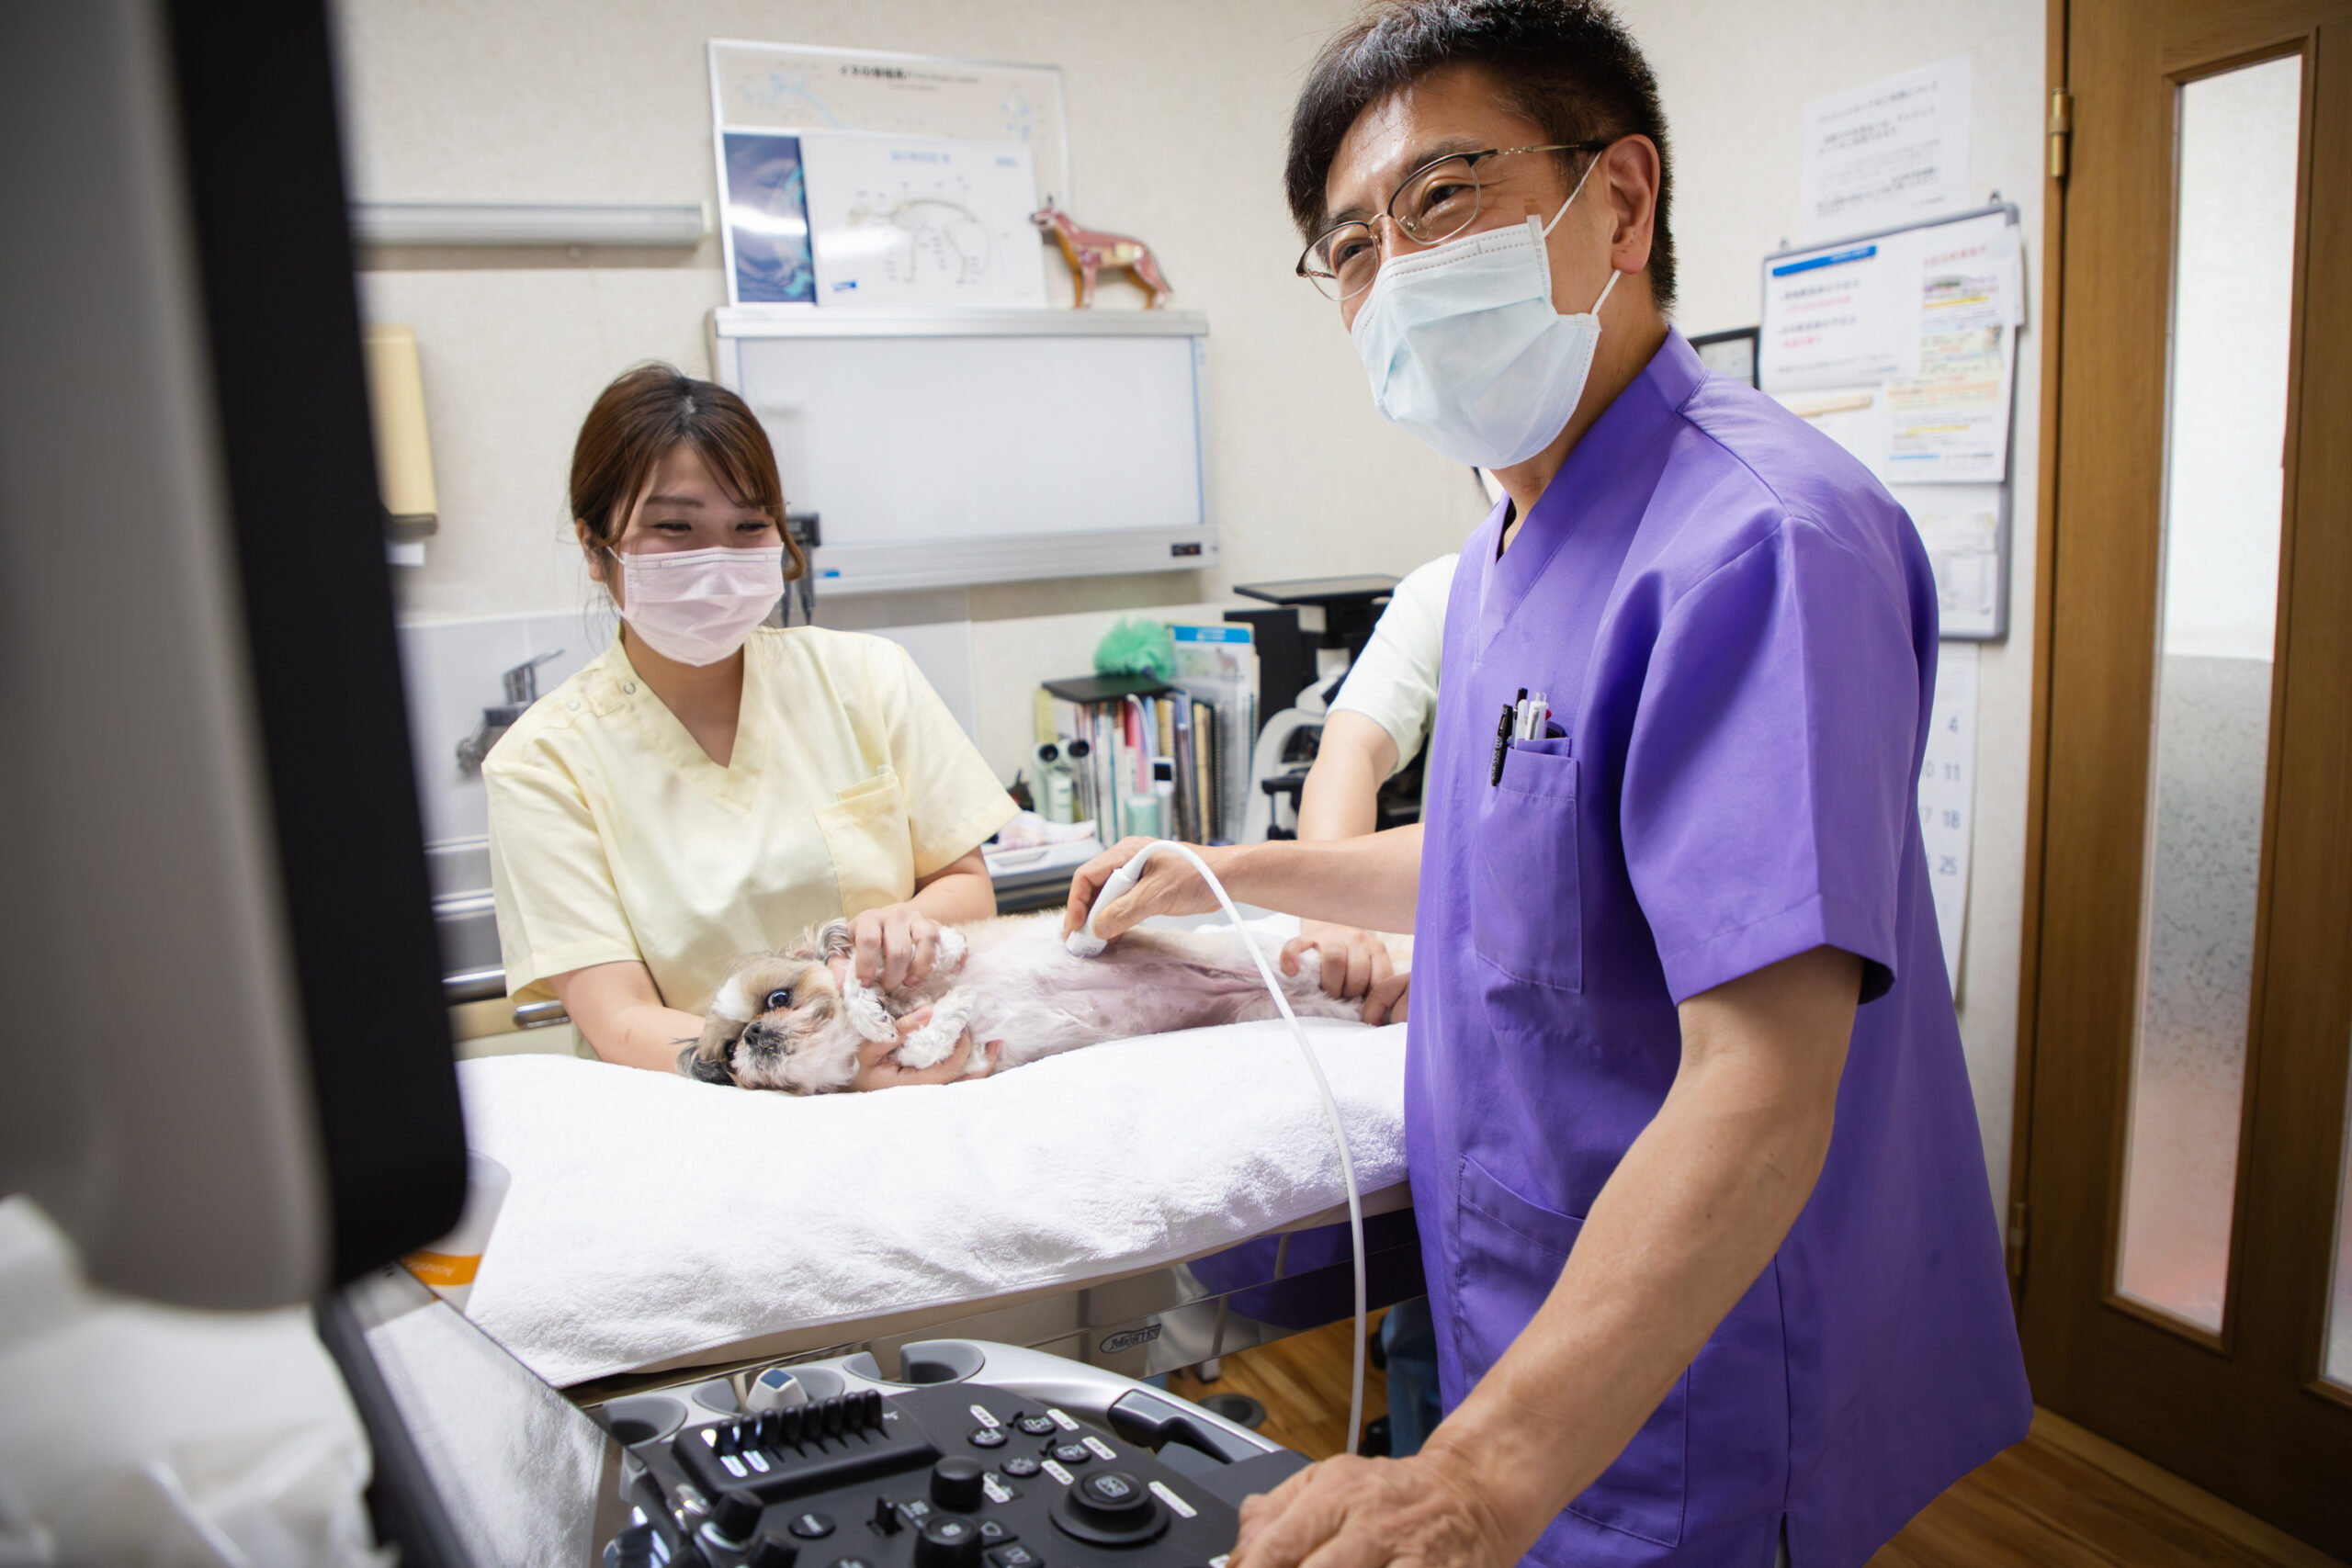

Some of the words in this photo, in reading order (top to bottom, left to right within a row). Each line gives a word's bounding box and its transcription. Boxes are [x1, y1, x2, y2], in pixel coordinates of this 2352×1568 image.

[1947, 715, 1958, 733] 4
[1944, 762, 1961, 782] 11
[1942, 809, 1961, 830] 18
[1939, 853, 1959, 876] 25
